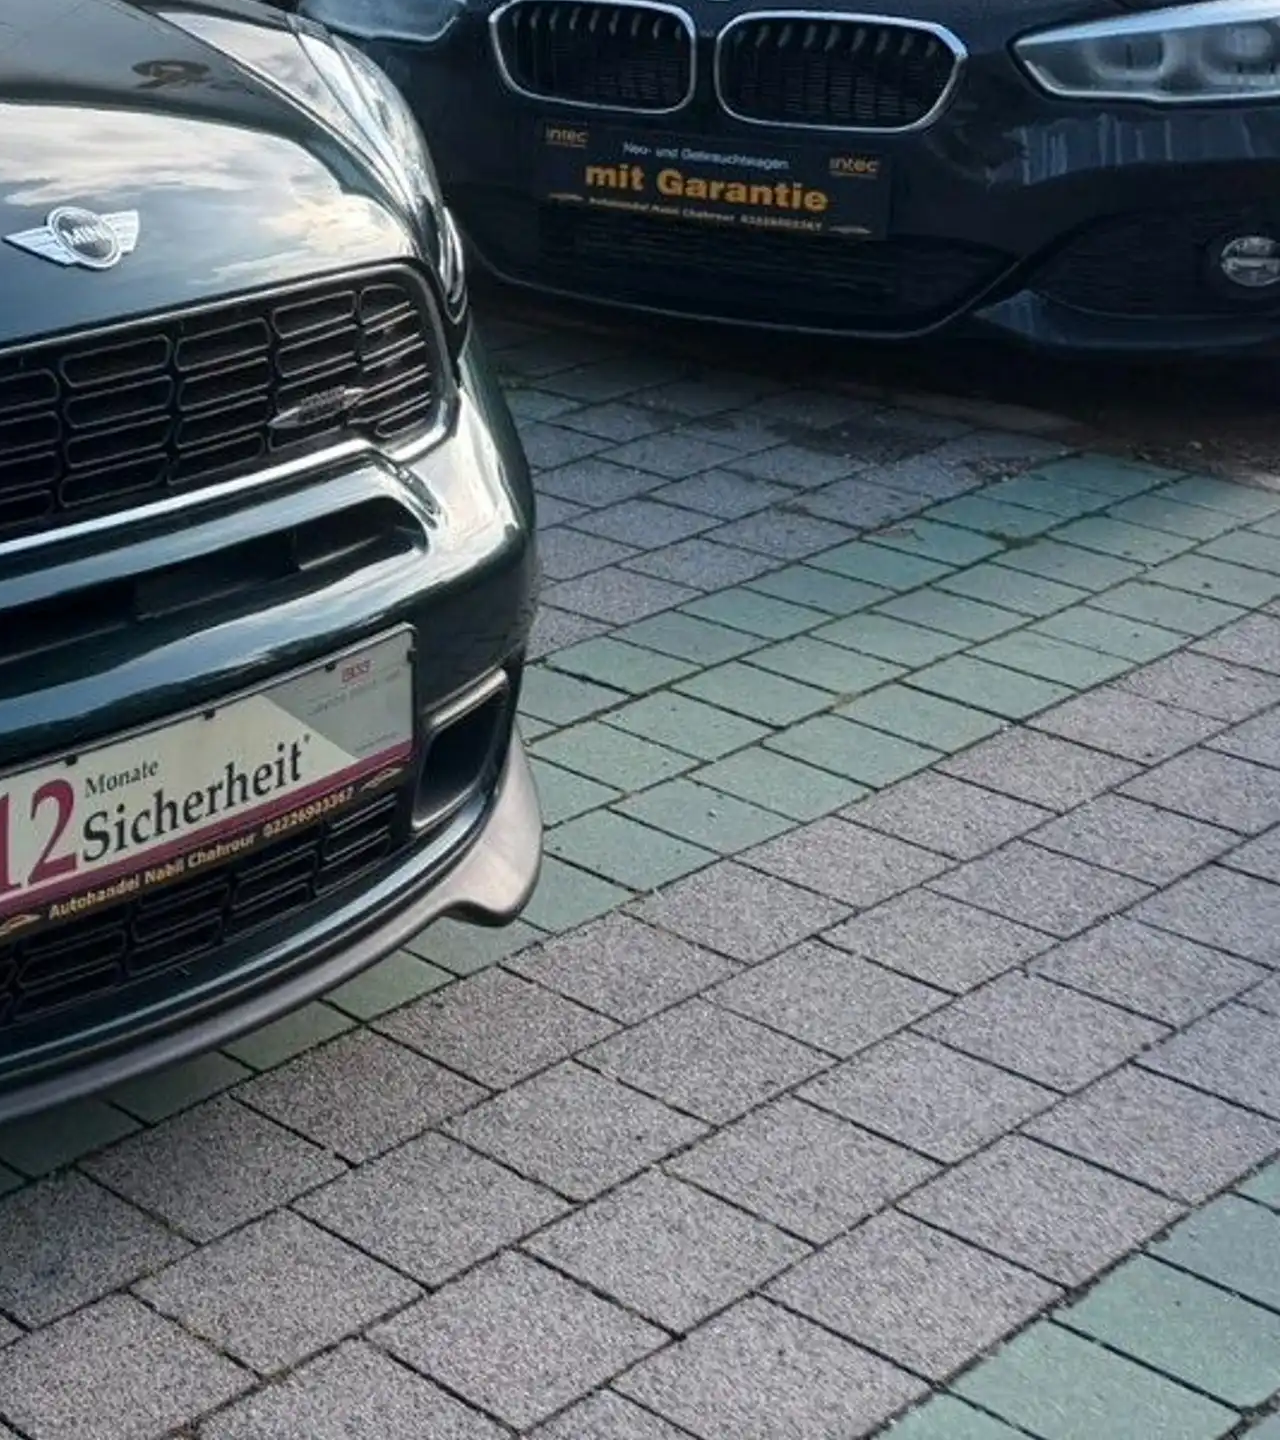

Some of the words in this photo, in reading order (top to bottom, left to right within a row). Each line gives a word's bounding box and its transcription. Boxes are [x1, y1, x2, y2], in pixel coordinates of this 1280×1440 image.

[585, 163, 645, 191] mit
[656, 169, 830, 213] Garantie
[83, 758, 160, 799] Monate
[48, 874, 140, 921] Autohandel
[187, 833, 258, 869] Chahrour
